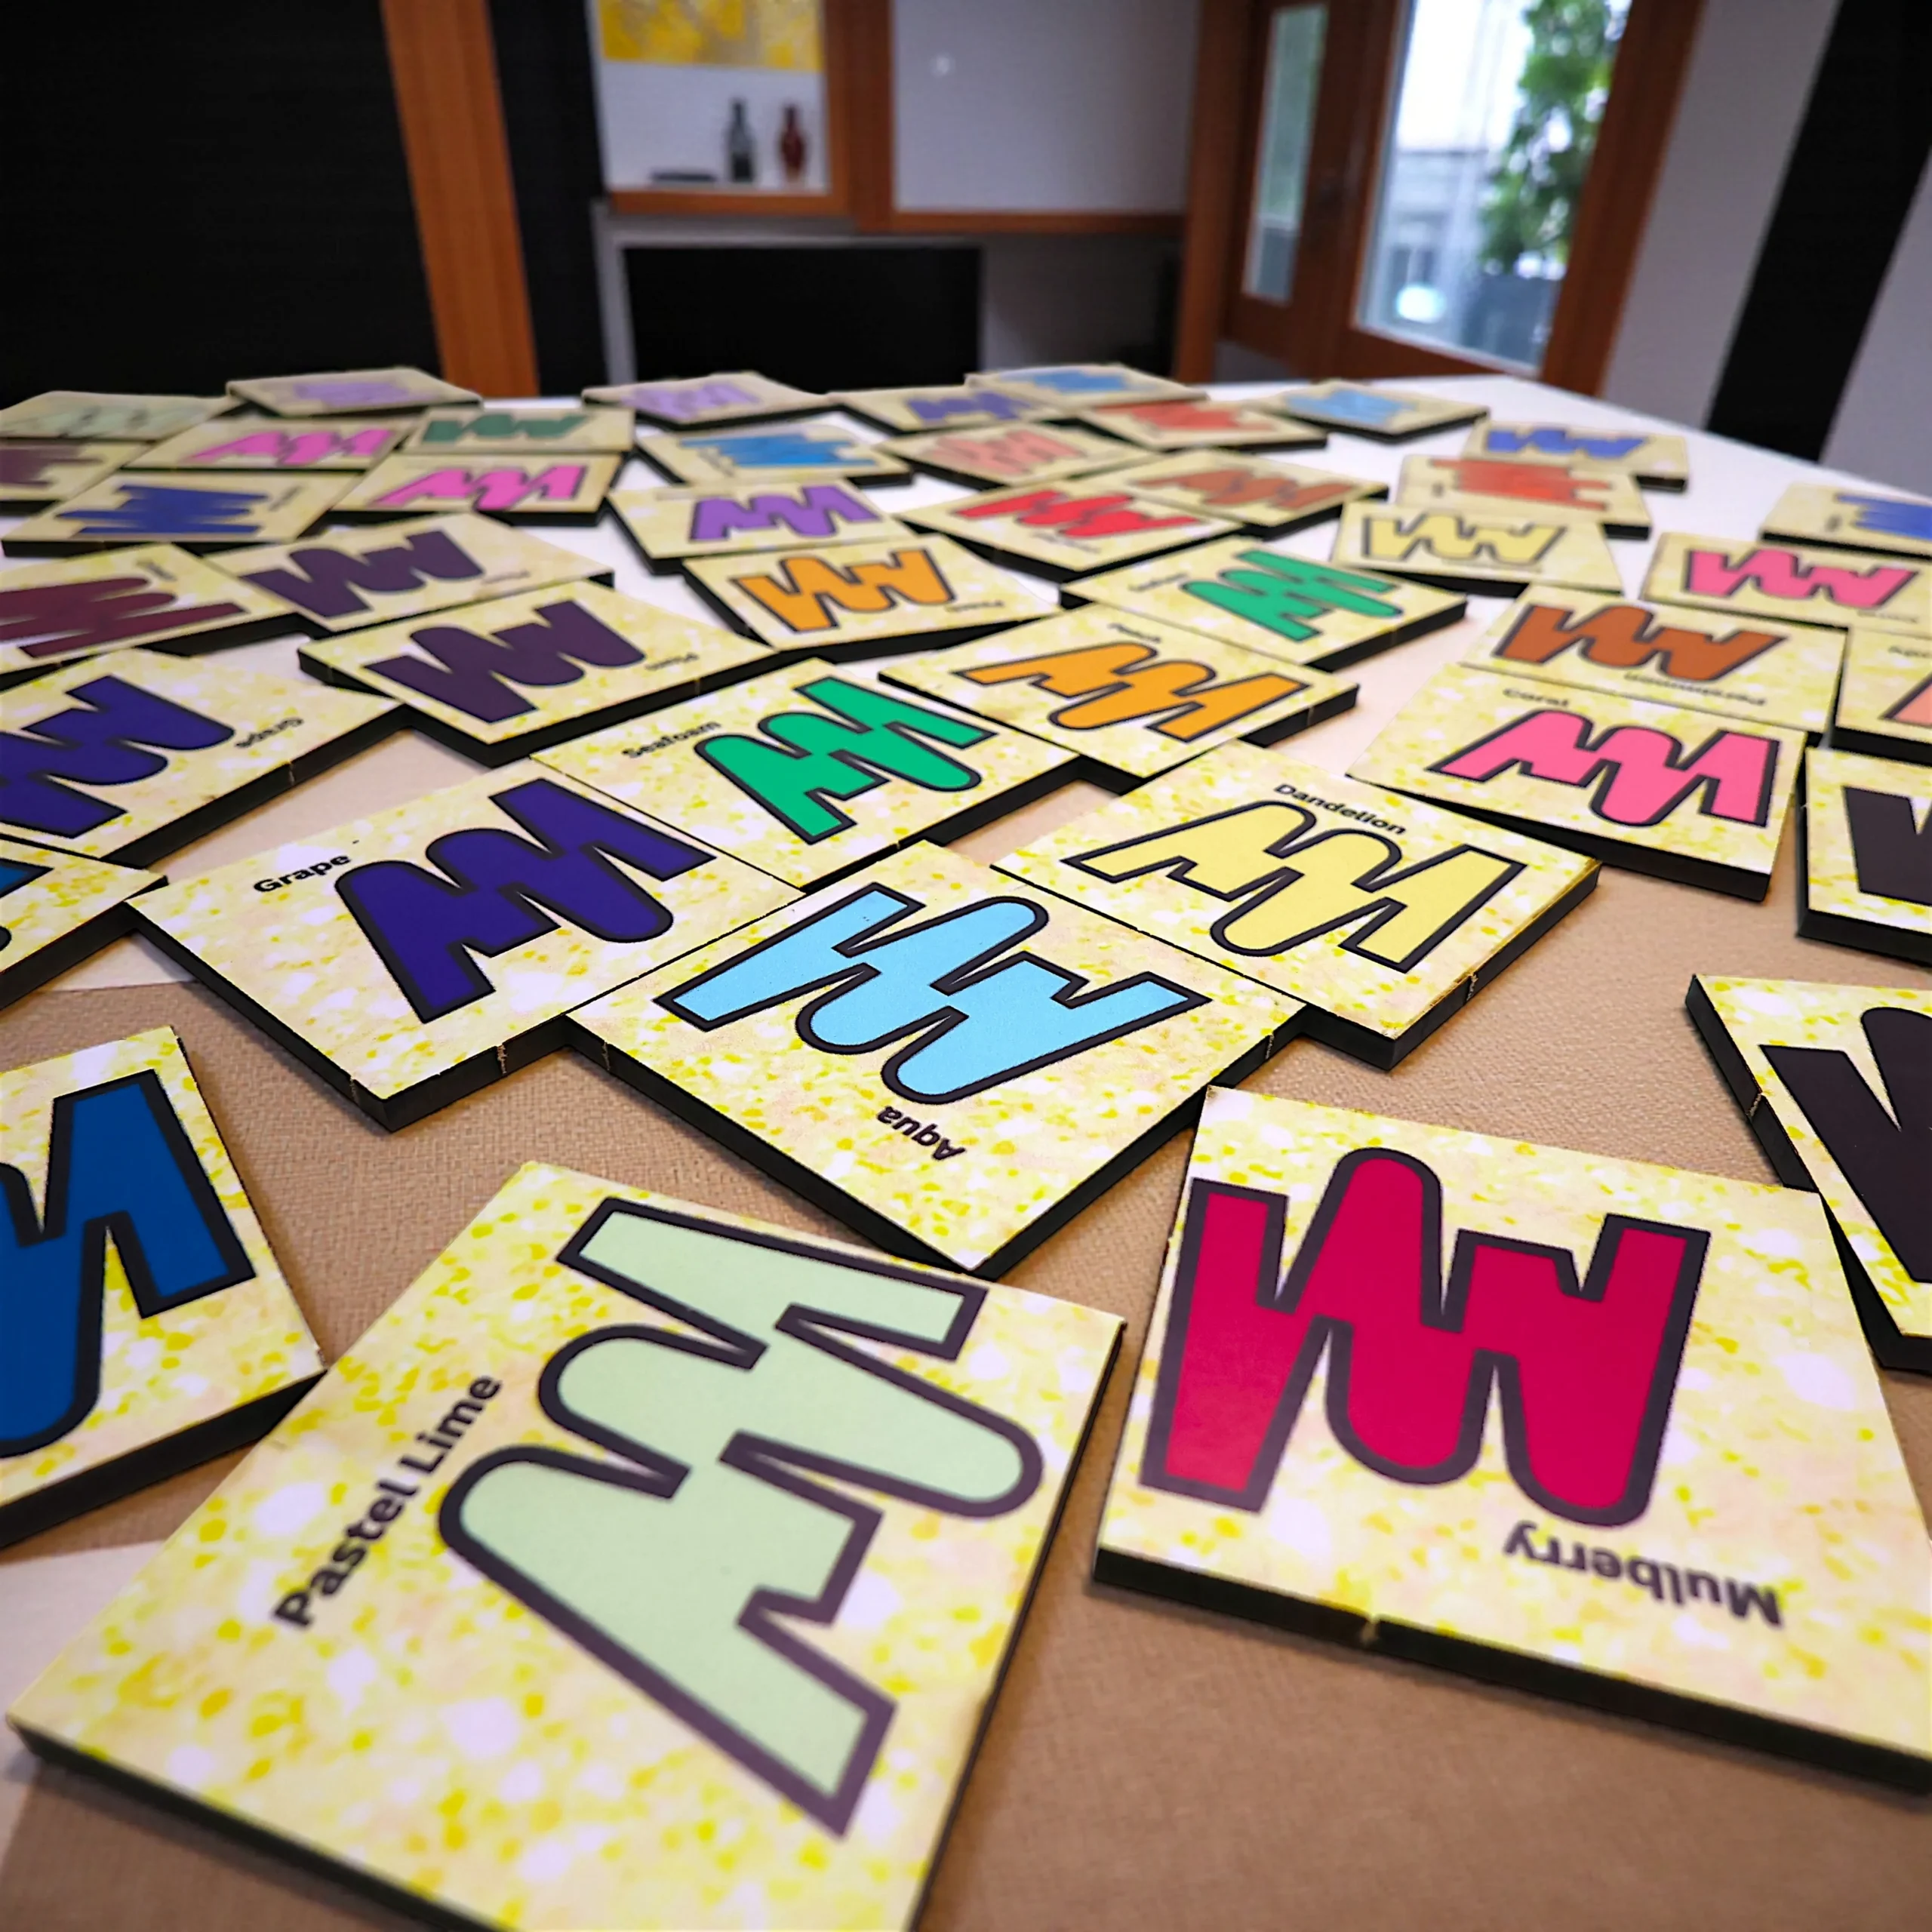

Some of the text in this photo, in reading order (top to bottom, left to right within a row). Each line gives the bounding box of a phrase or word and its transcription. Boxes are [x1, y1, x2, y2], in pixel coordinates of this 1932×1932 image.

[1503, 688, 1570, 706] Coral
[622, 721, 721, 758] Seafoam
[1275, 783, 1406, 835] Dandelion
[254, 855, 351, 892] Grape
[876, 1105, 967, 1161] Aqua
[274, 1377, 502, 1628] Pastel Lime
[1503, 1519, 1783, 1628] Mulberry
